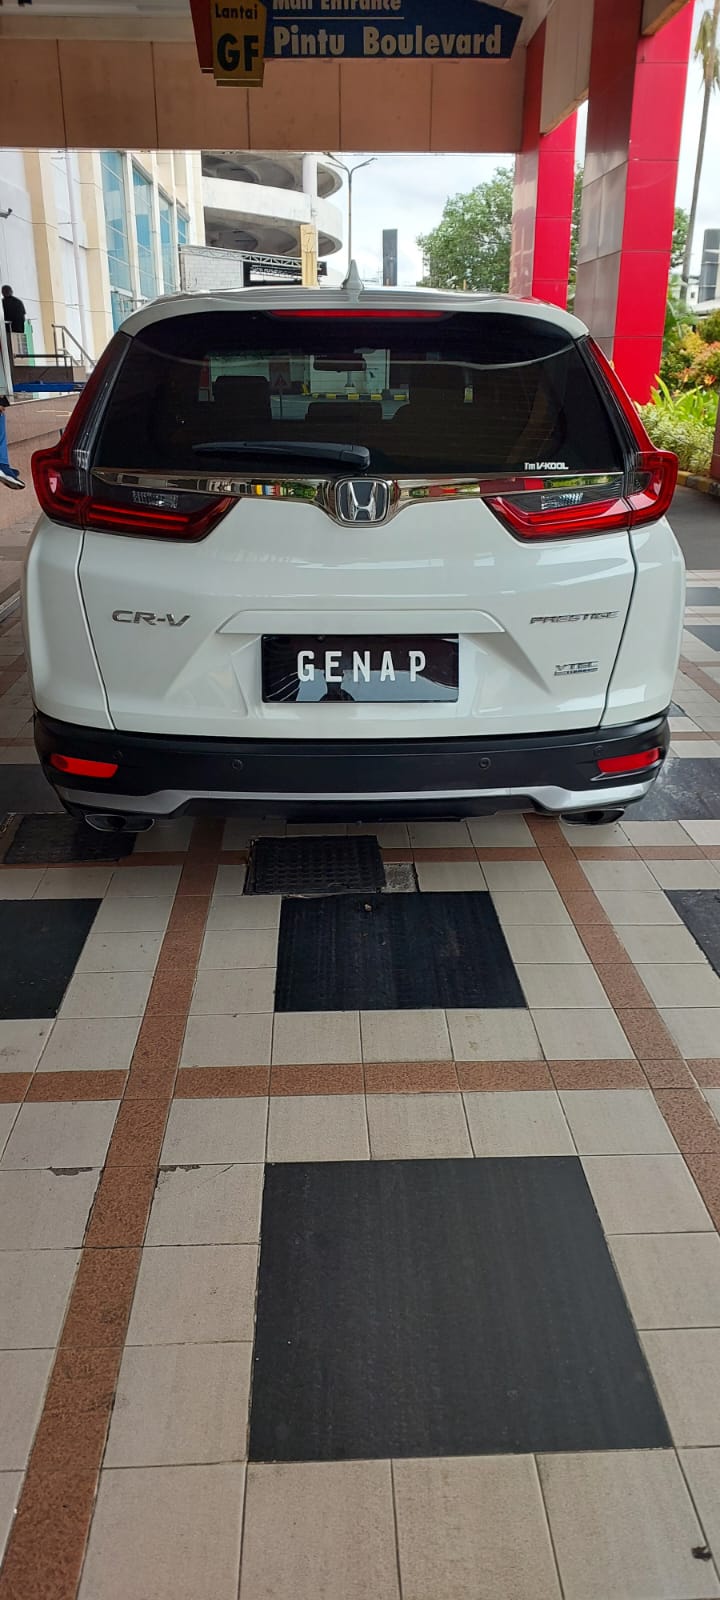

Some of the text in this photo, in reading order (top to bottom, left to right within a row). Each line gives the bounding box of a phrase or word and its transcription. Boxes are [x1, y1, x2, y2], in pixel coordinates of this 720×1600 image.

[214, 3, 258, 19] Lantai
[216, 33, 259, 71] GF
[273, 25, 502, 56] Pintu Boulevard
[111, 609, 190, 626] CR-V
[529, 610, 620, 625] PRESTIGE
[297, 650, 426, 682] GENAP
